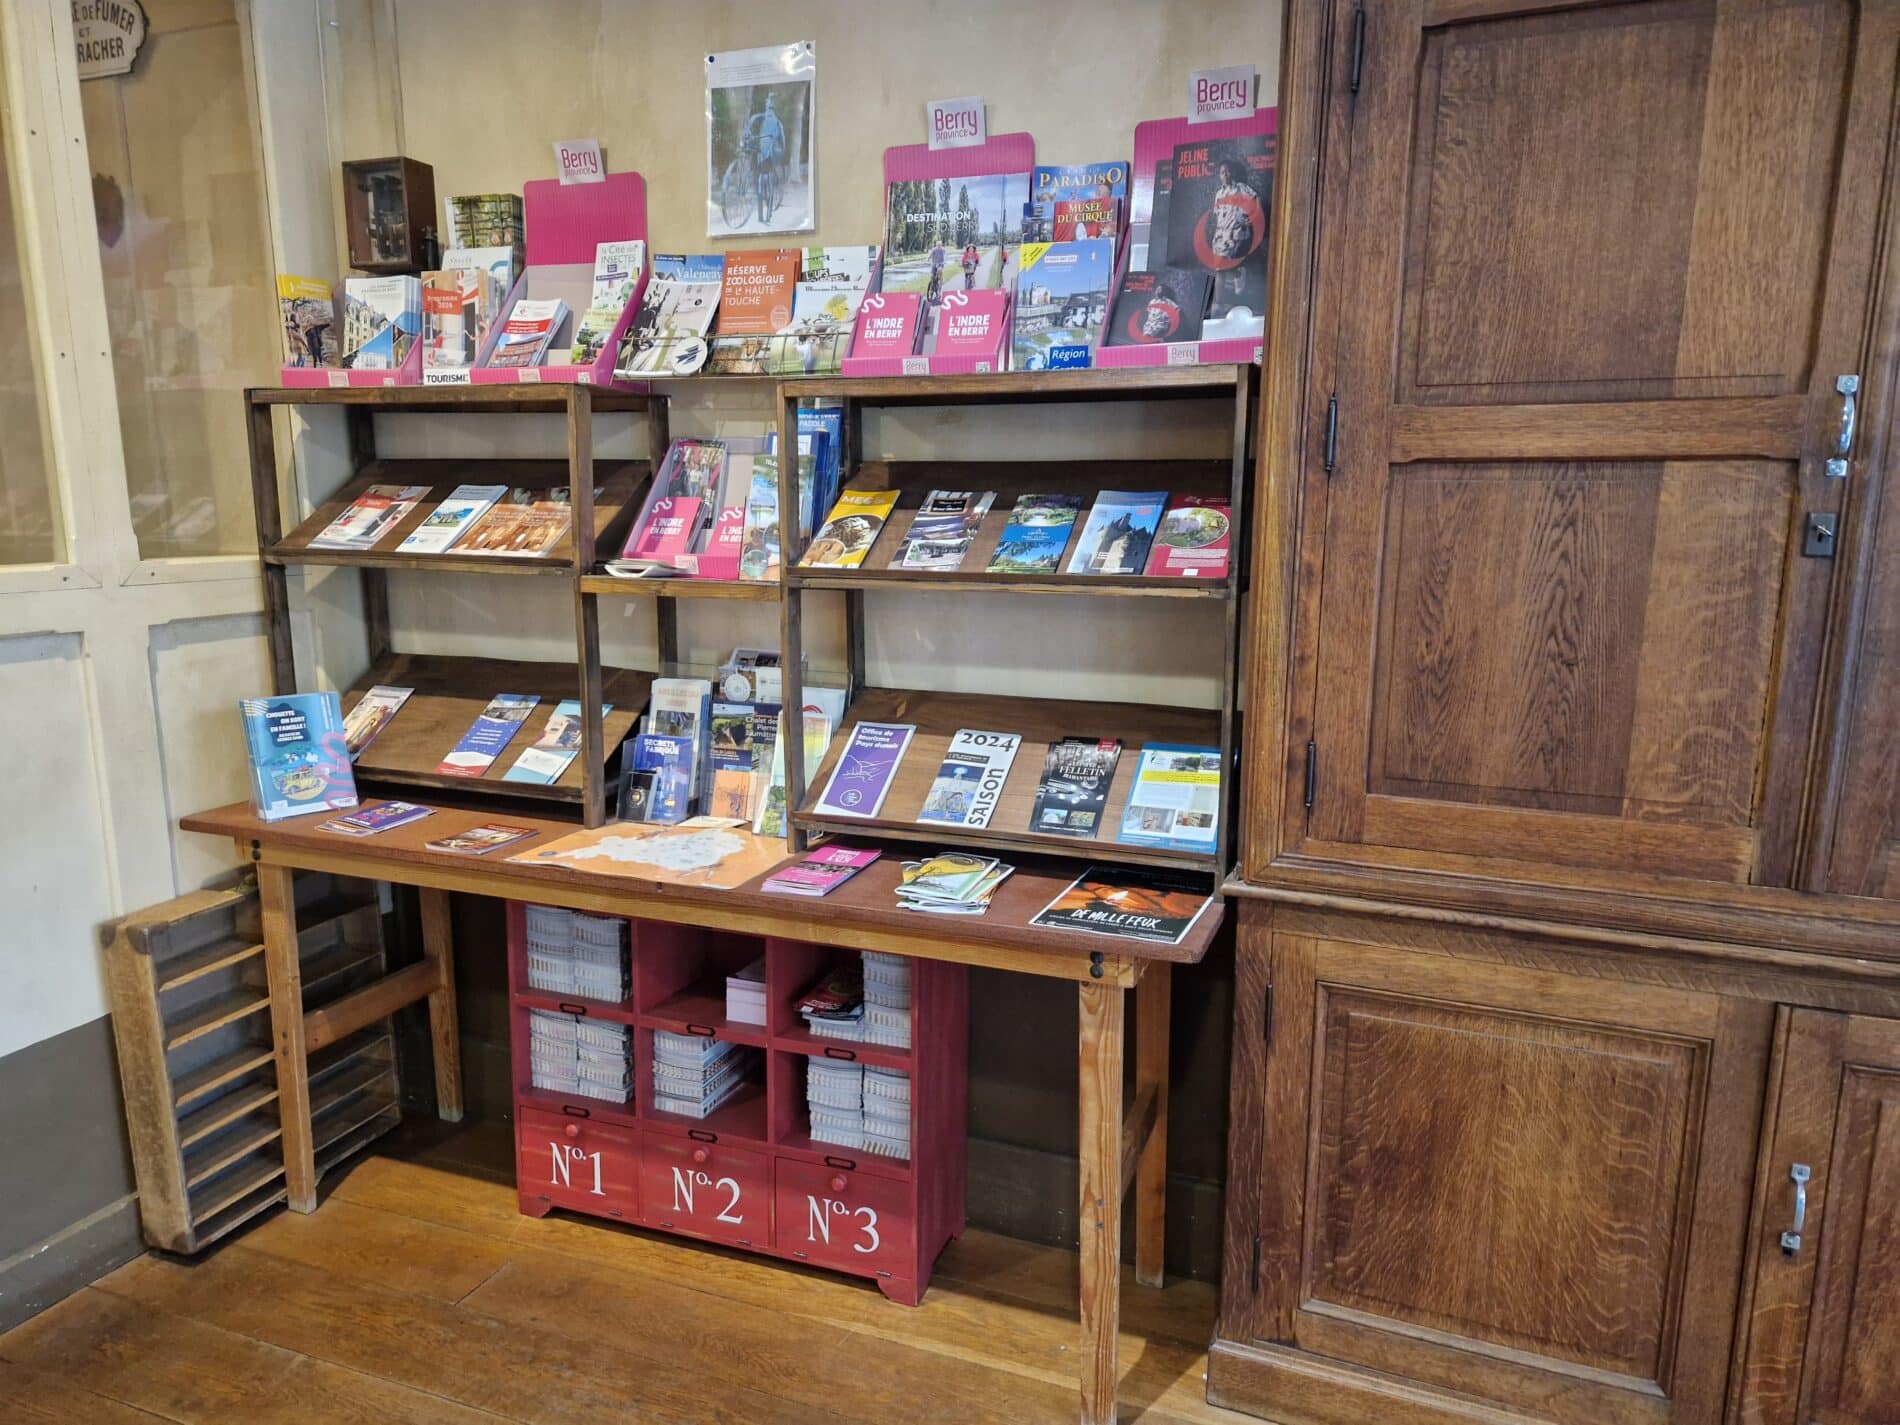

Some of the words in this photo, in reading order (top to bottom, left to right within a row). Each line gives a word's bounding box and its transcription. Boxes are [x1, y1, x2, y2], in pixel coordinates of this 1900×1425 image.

[81, 5, 93, 20] DE
[95, 0, 135, 35] FUMER
[79, 27, 91, 37] ET
[76, 36, 125, 63] RACHER
[1197, 78, 1247, 108] Berry
[1197, 100, 1235, 116] province
[934, 108, 978, 136] Berry
[935, 129, 969, 145] province
[560, 148, 598, 174] Berry
[1039, 167, 1122, 188] PARADISO
[906, 210, 971, 223] DESTINATION
[1057, 214, 1072, 224] DU
[1073, 209, 1114, 223] CIRQUE
[727, 264, 768, 276] RÉSERVE
[726, 274, 785, 286] ZOOLOGIQUE
[725, 295, 761, 306] TOUCHE
[866, 317, 905, 329] L'INDRE
[949, 314, 991, 326] L'INDRE
[864, 329, 875, 339] EN
[876, 329, 903, 339] BERRY
[948, 326, 960, 337] EN
[960, 326, 989, 336] BERRY
[1051, 348, 1086, 361] Région
[960, 732, 1014, 752] 2024
[1059, 765, 1106, 777] FELLETIN
[968, 768, 1004, 825] SAISON
[1071, 909, 1091, 918] DE
[1088, 911, 1128, 925] MILLE
[1125, 914, 1162, 929] FEUX
